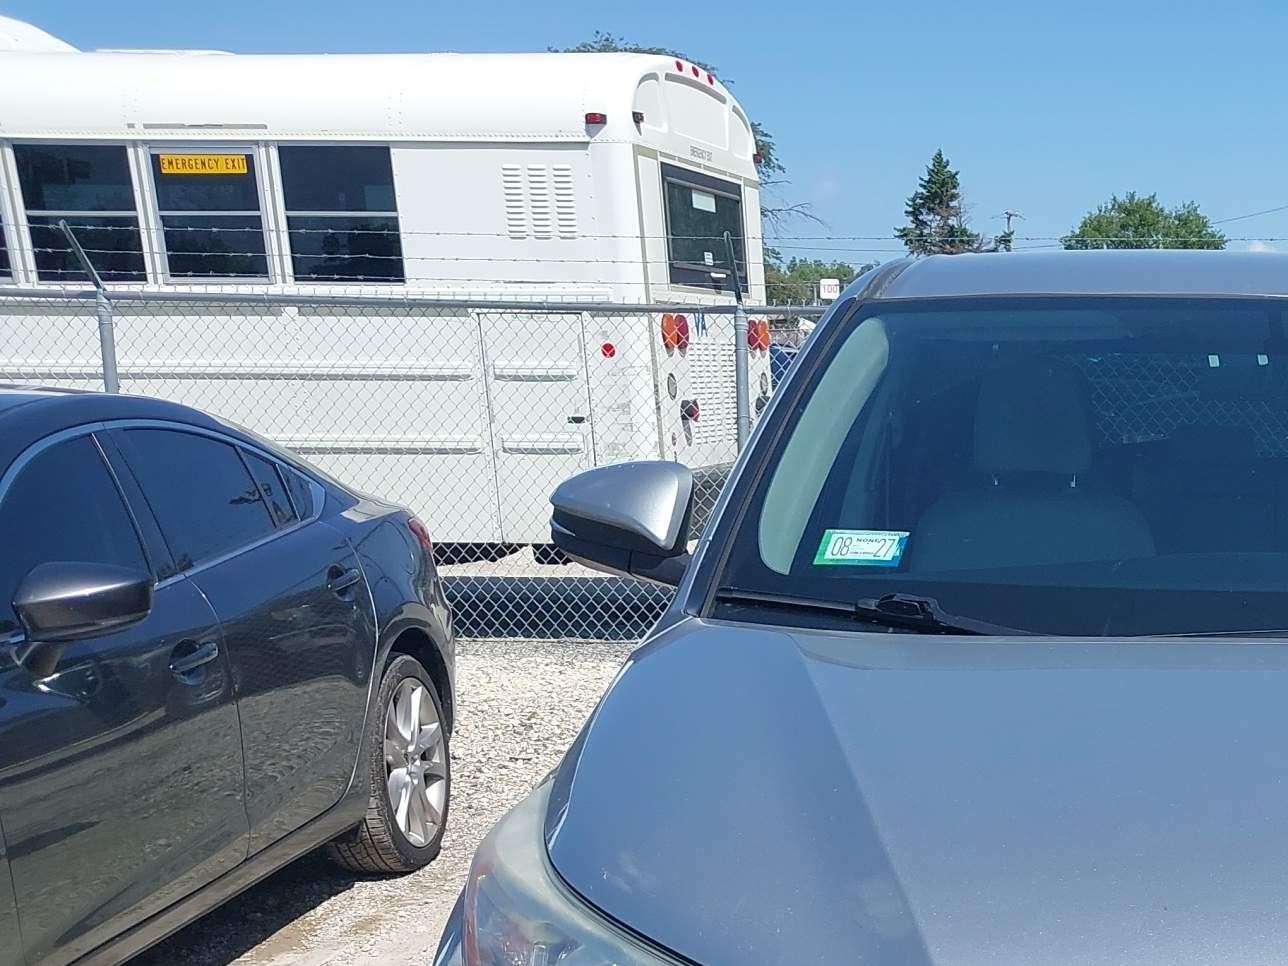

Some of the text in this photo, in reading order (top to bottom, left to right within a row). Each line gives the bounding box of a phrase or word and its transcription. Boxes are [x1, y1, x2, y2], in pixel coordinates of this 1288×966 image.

[161, 158, 246, 170] EMERGENCY EXIT
[831, 536, 853, 556] 08
[873, 538, 897, 558] 27
